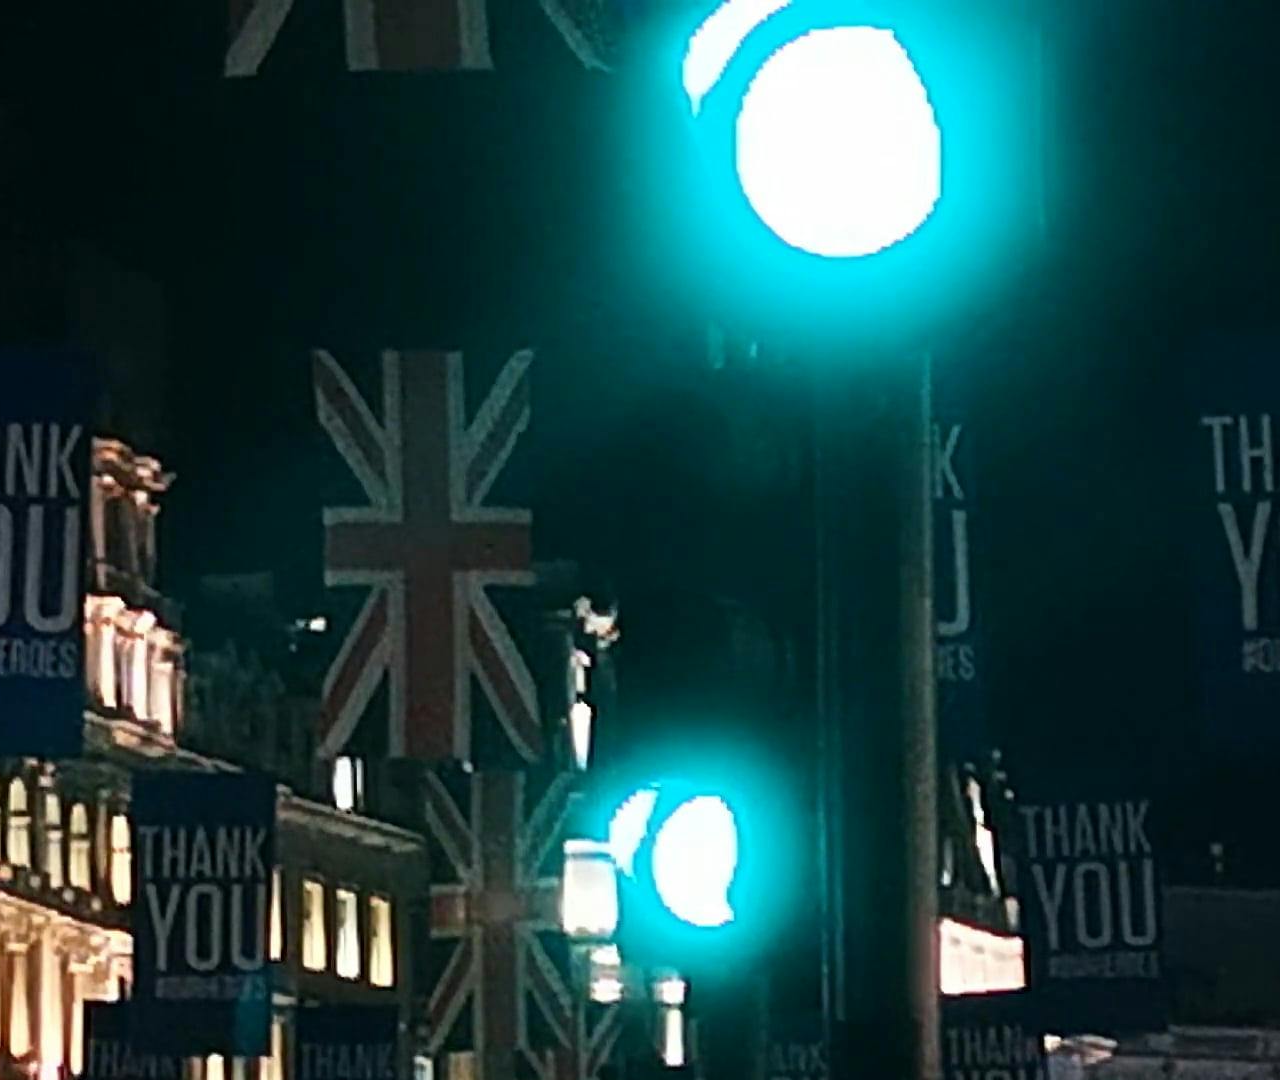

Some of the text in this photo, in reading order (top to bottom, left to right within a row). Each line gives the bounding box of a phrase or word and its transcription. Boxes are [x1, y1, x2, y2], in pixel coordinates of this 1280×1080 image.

[139, 826, 268, 879] THANK
[1020, 800, 1152, 858] THANK
[145, 881, 267, 973] YOU
[1031, 858, 1158, 951] YOU
[302, 1043, 393, 1080] THANK
